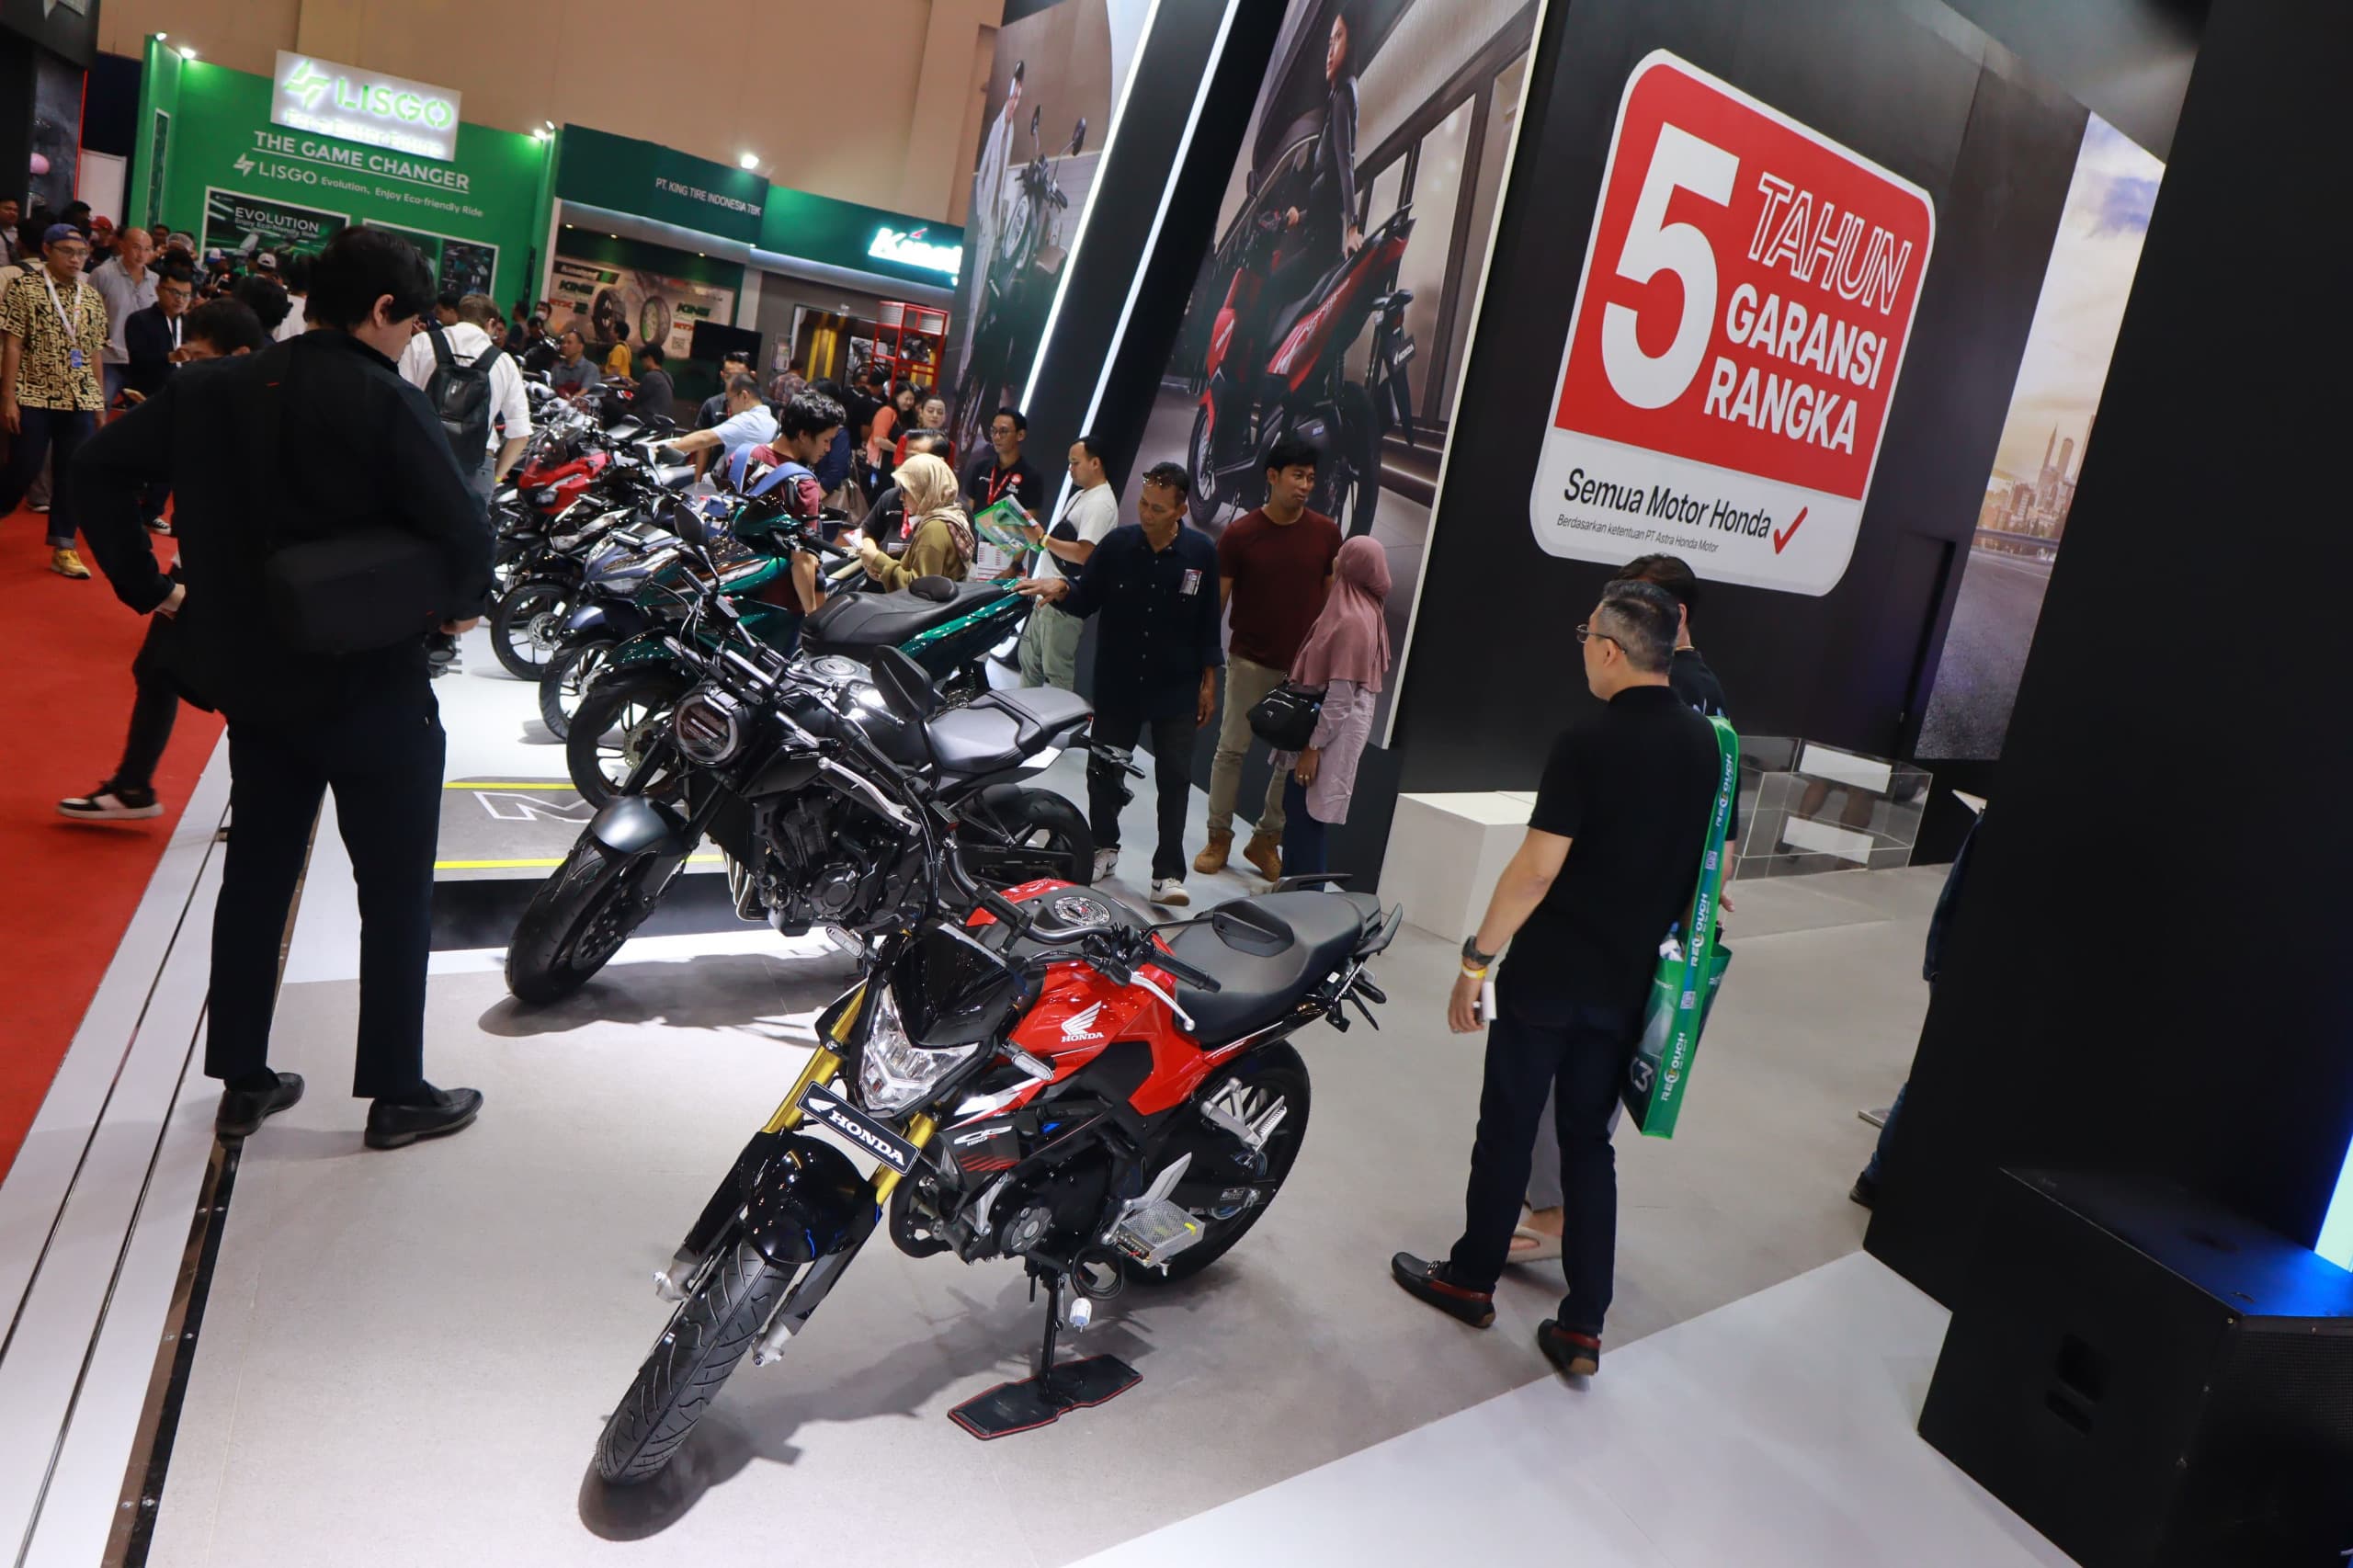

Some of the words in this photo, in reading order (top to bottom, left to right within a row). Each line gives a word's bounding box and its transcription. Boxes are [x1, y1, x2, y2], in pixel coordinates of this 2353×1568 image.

[337, 77, 453, 128] LISGO
[254, 131, 295, 153] THE
[301, 141, 363, 167] GAME
[369, 155, 470, 189] CHANGER
[258, 162, 317, 185] LISGO
[375, 187, 401, 201] Enjoy
[404, 193, 460, 214] Eco-friendly
[462, 205, 483, 218] Ride
[668, 182, 688, 196] KING
[689, 187, 707, 201] TIRE
[707, 192, 746, 211] INDONESIA
[234, 206, 320, 233] EVOLUTION
[1601, 121, 1740, 410] 5
[1747, 171, 1913, 315] TAHUN
[1726, 283, 1888, 390] GARANSI
[1703, 356, 1859, 455] RANGKA
[1564, 467, 1643, 515] Semua
[1645, 484, 1709, 527] Motor
[1709, 498, 1771, 540] Honda
[1557, 514, 1607, 535] Berdasarkan
[1607, 519, 1645, 540] ketentuan
[1644, 529, 1654, 541] PT
[1654, 531, 1675, 546] Astra
[1675, 534, 1699, 550] Honda
[1699, 537, 1720, 552] Motor
[1061, 1031, 1104, 1042] HONDA
[829, 1110, 905, 1166] HONDA
